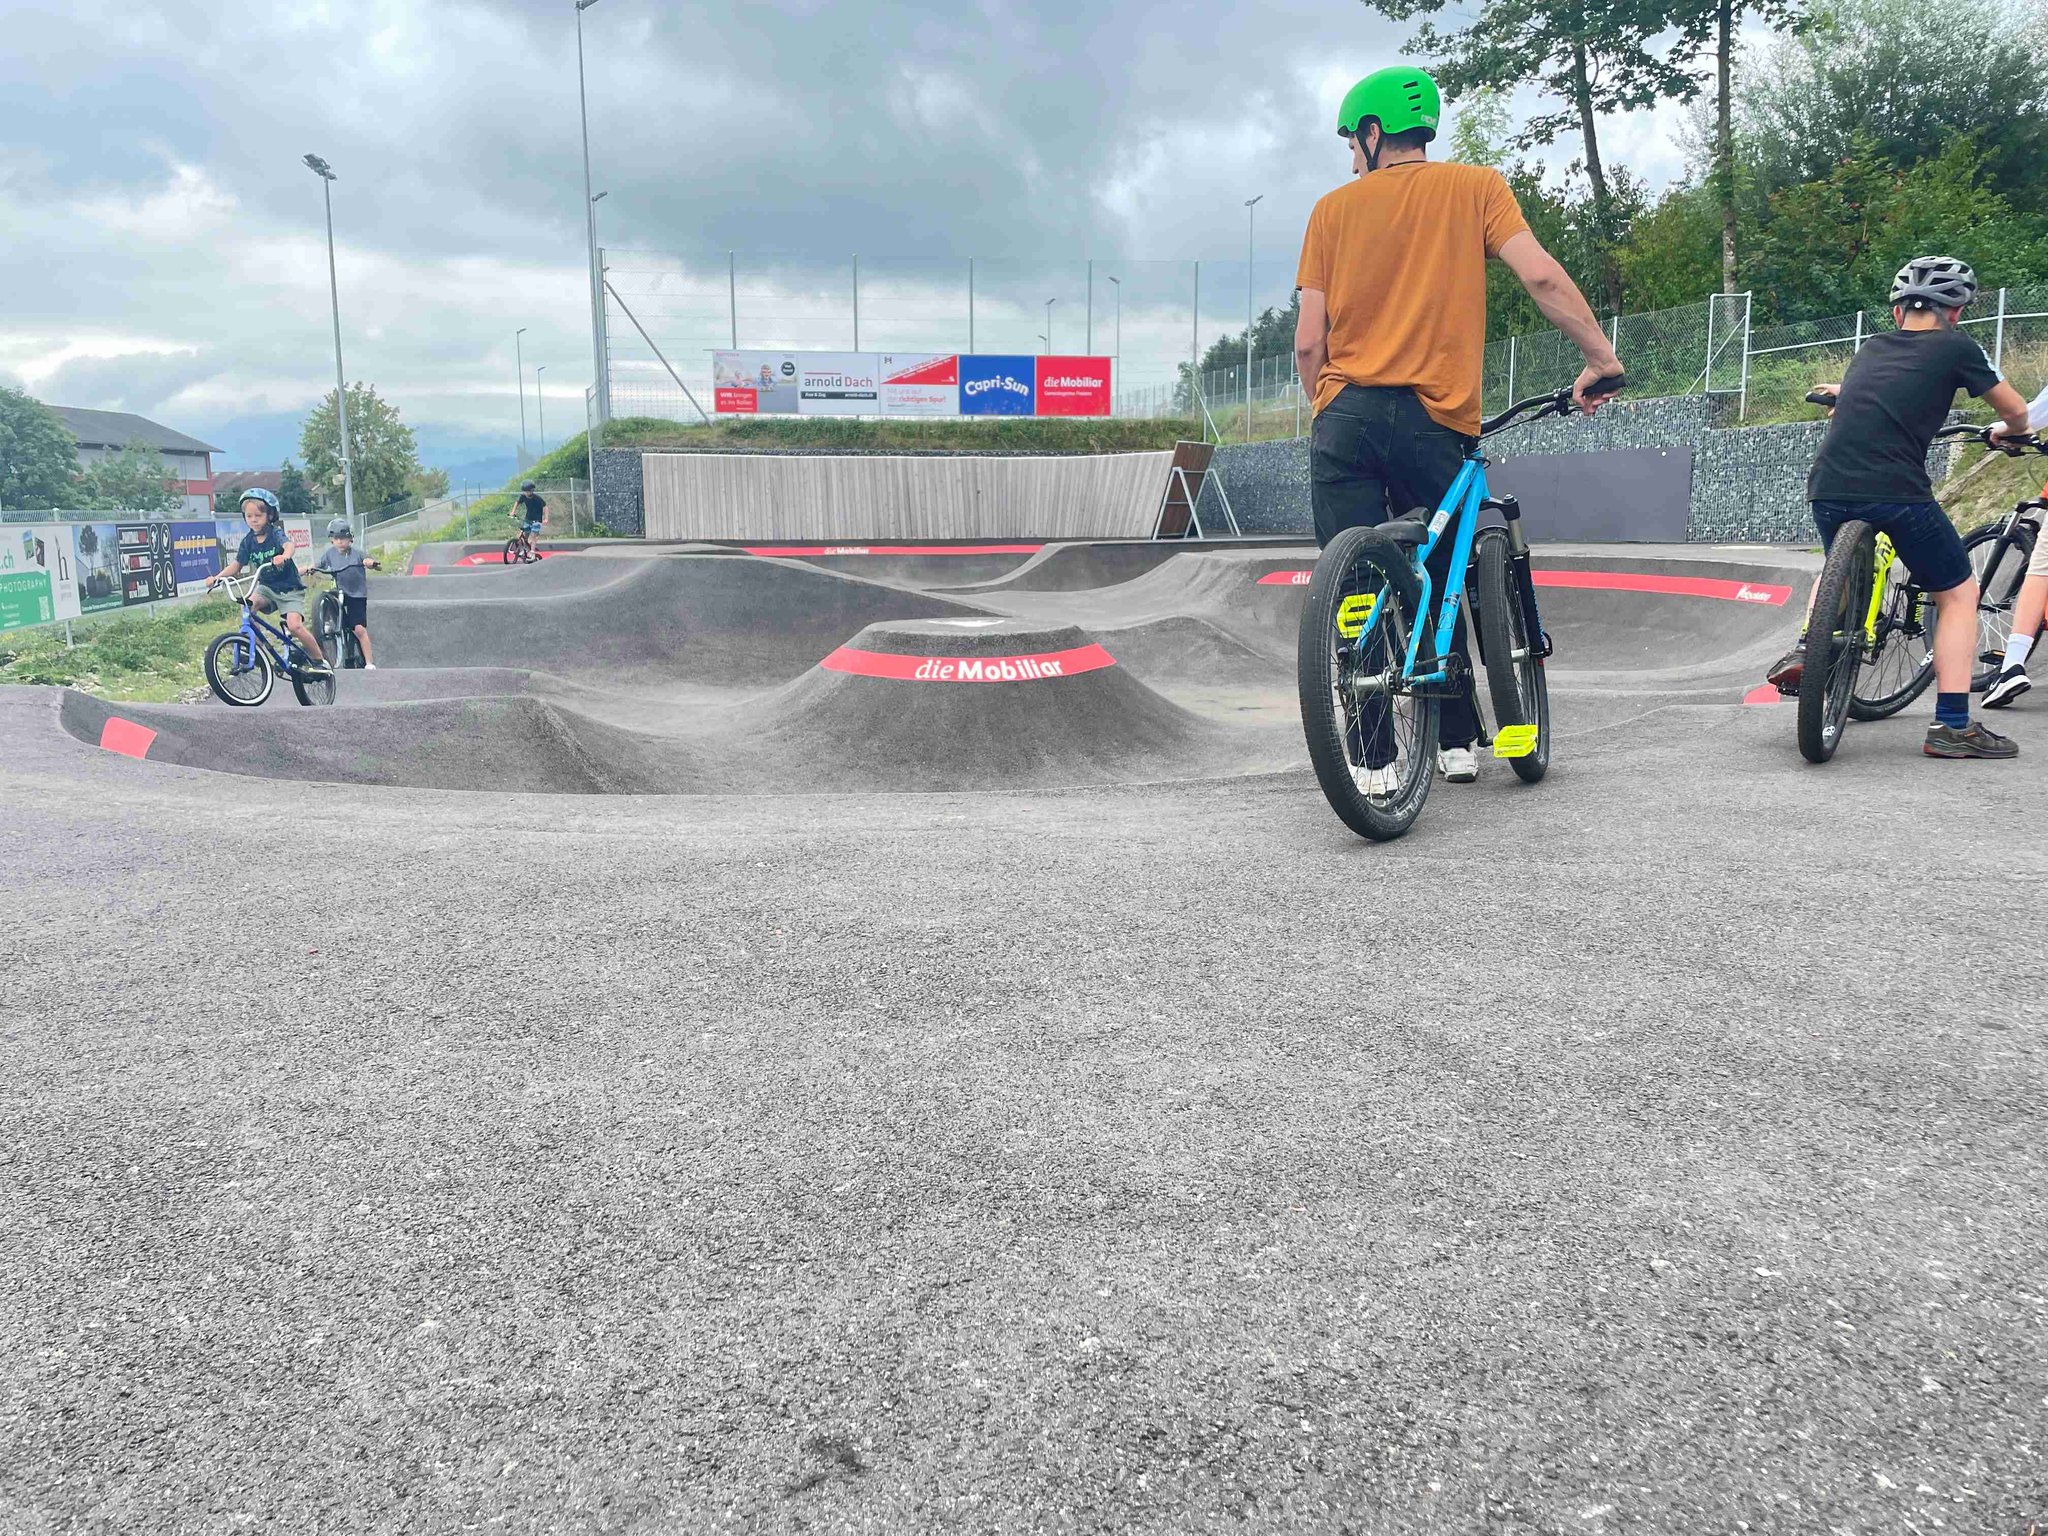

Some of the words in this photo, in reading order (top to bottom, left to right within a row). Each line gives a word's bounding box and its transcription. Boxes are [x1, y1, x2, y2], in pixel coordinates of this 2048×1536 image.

[804, 376, 842, 387] arnold
[844, 376, 873, 387] Dach
[964, 375, 1029, 396] Capri-Sun
[1044, 376, 1060, 388] die
[1060, 376, 1103, 388] Mobiliar
[179, 535, 207, 556] SUTER
[914, 659, 954, 679] die
[957, 659, 1064, 680] Mobiliar
